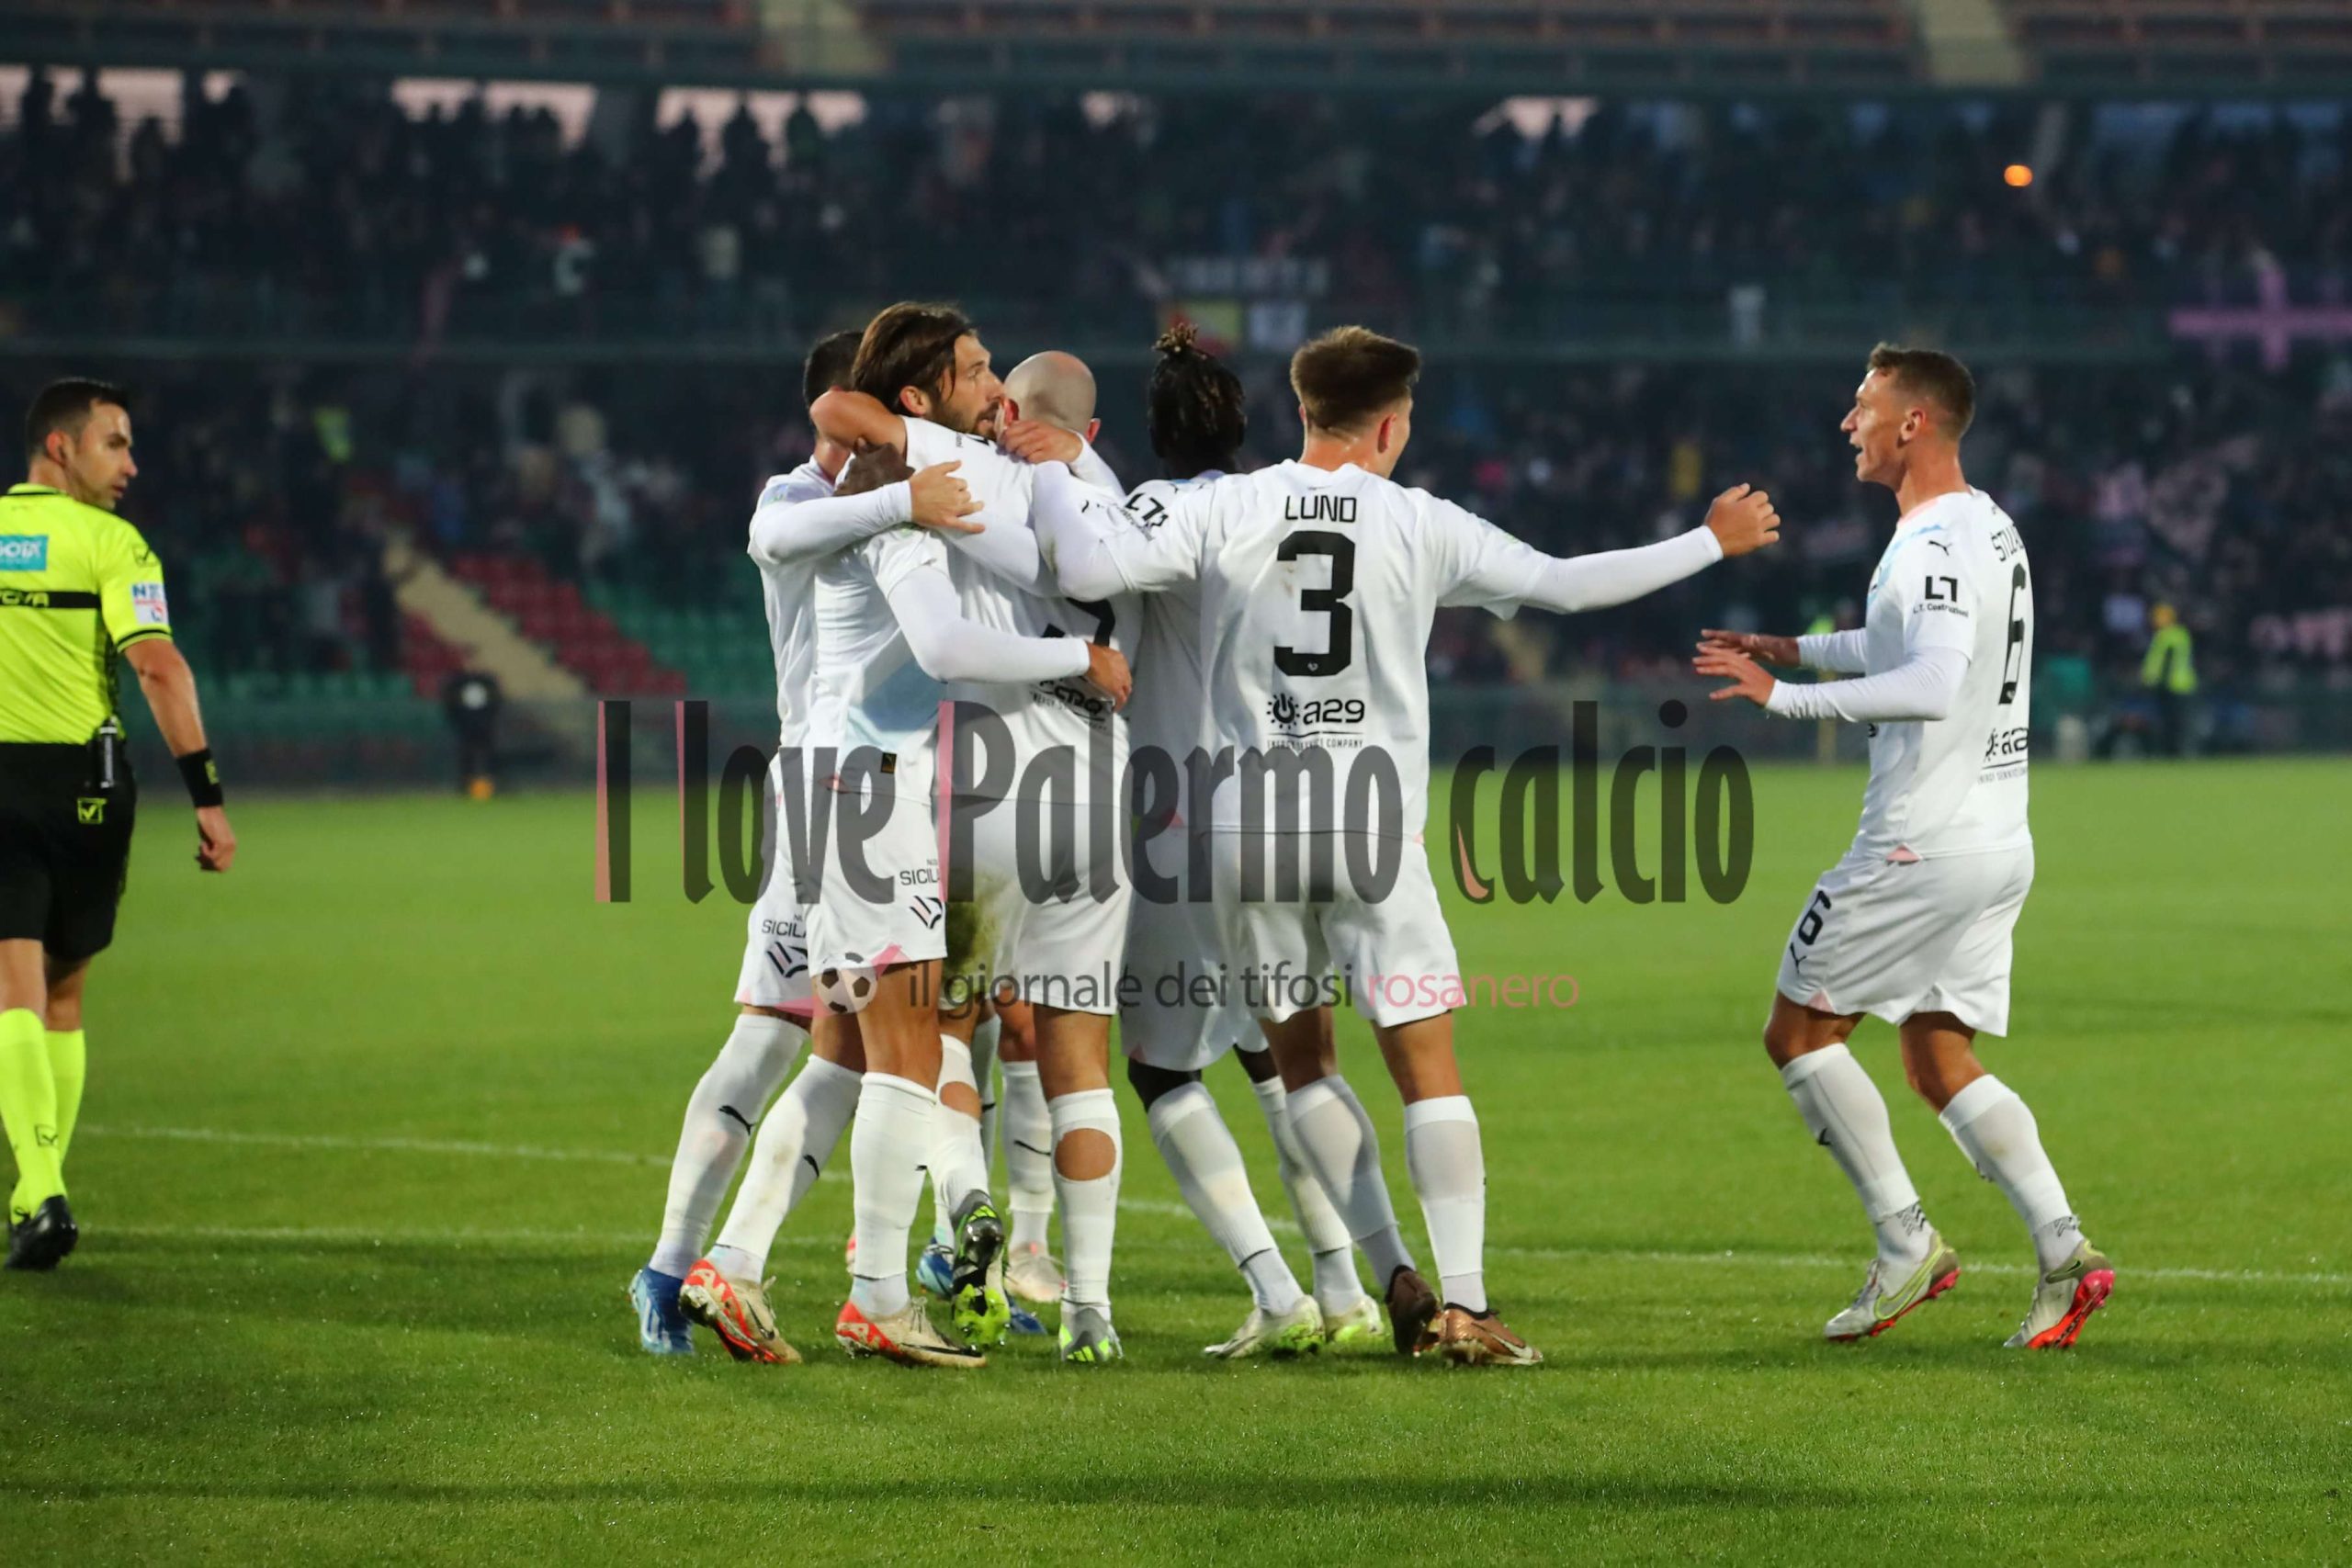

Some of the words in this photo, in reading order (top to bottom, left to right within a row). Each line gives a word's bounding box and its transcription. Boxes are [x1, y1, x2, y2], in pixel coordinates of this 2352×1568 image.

[1285, 495, 1356, 523] LUND
[1274, 531, 1355, 676] 3
[1998, 562, 2026, 705] 6
[1303, 698, 1365, 725] a29
[1798, 890, 1831, 945] 6
